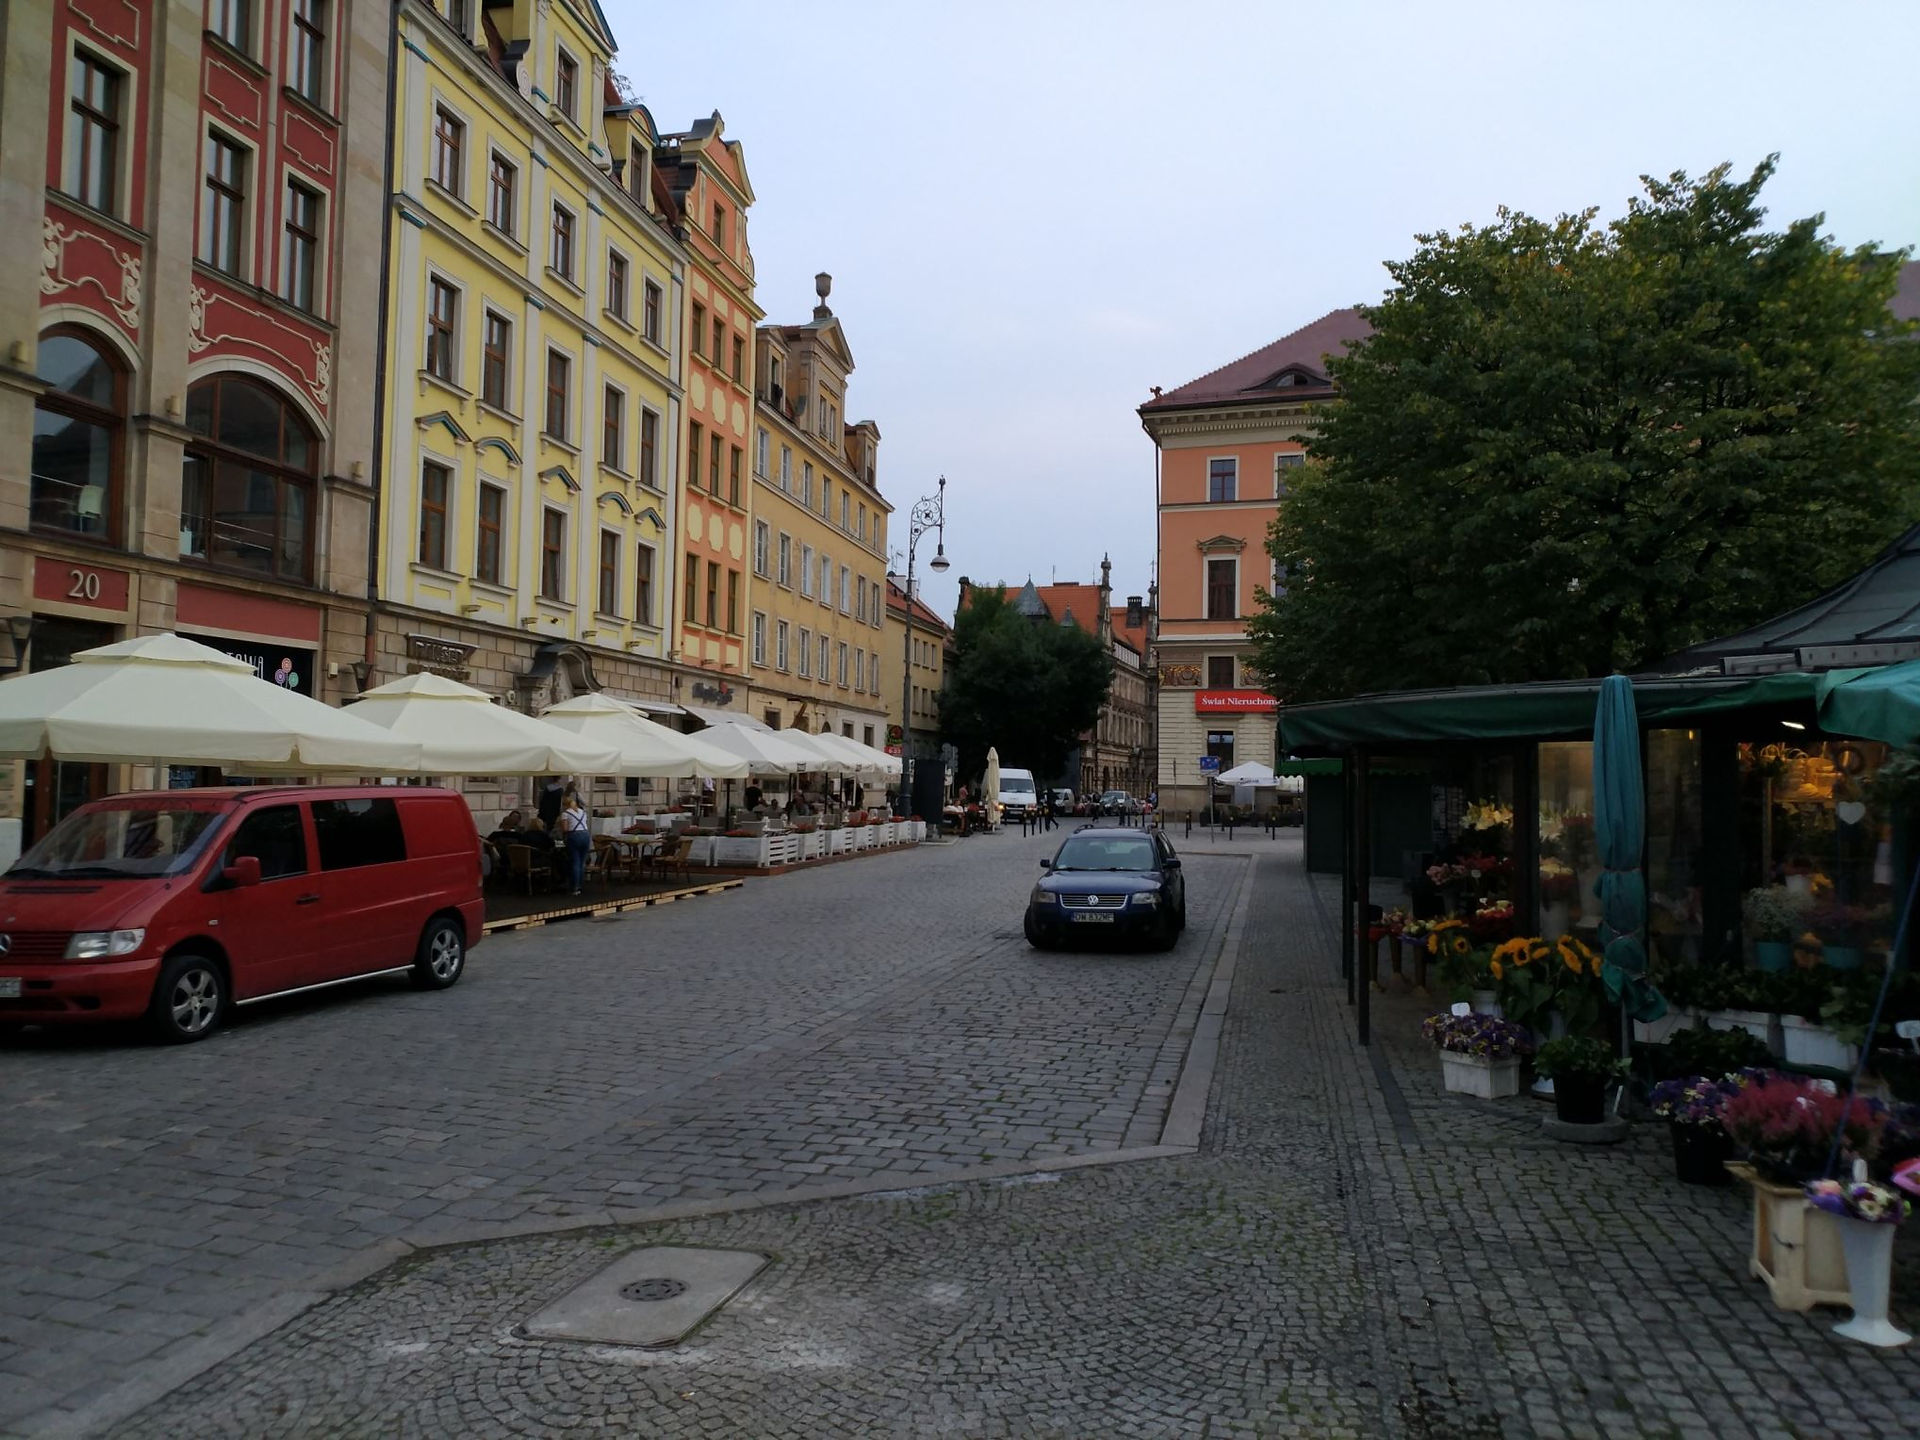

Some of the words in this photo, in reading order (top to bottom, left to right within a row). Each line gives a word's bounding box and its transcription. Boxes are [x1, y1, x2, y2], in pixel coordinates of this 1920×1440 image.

[68, 569, 99, 599] 20
[1202, 695, 1226, 705] Świat
[1227, 696, 1280, 705] Nieruchom
